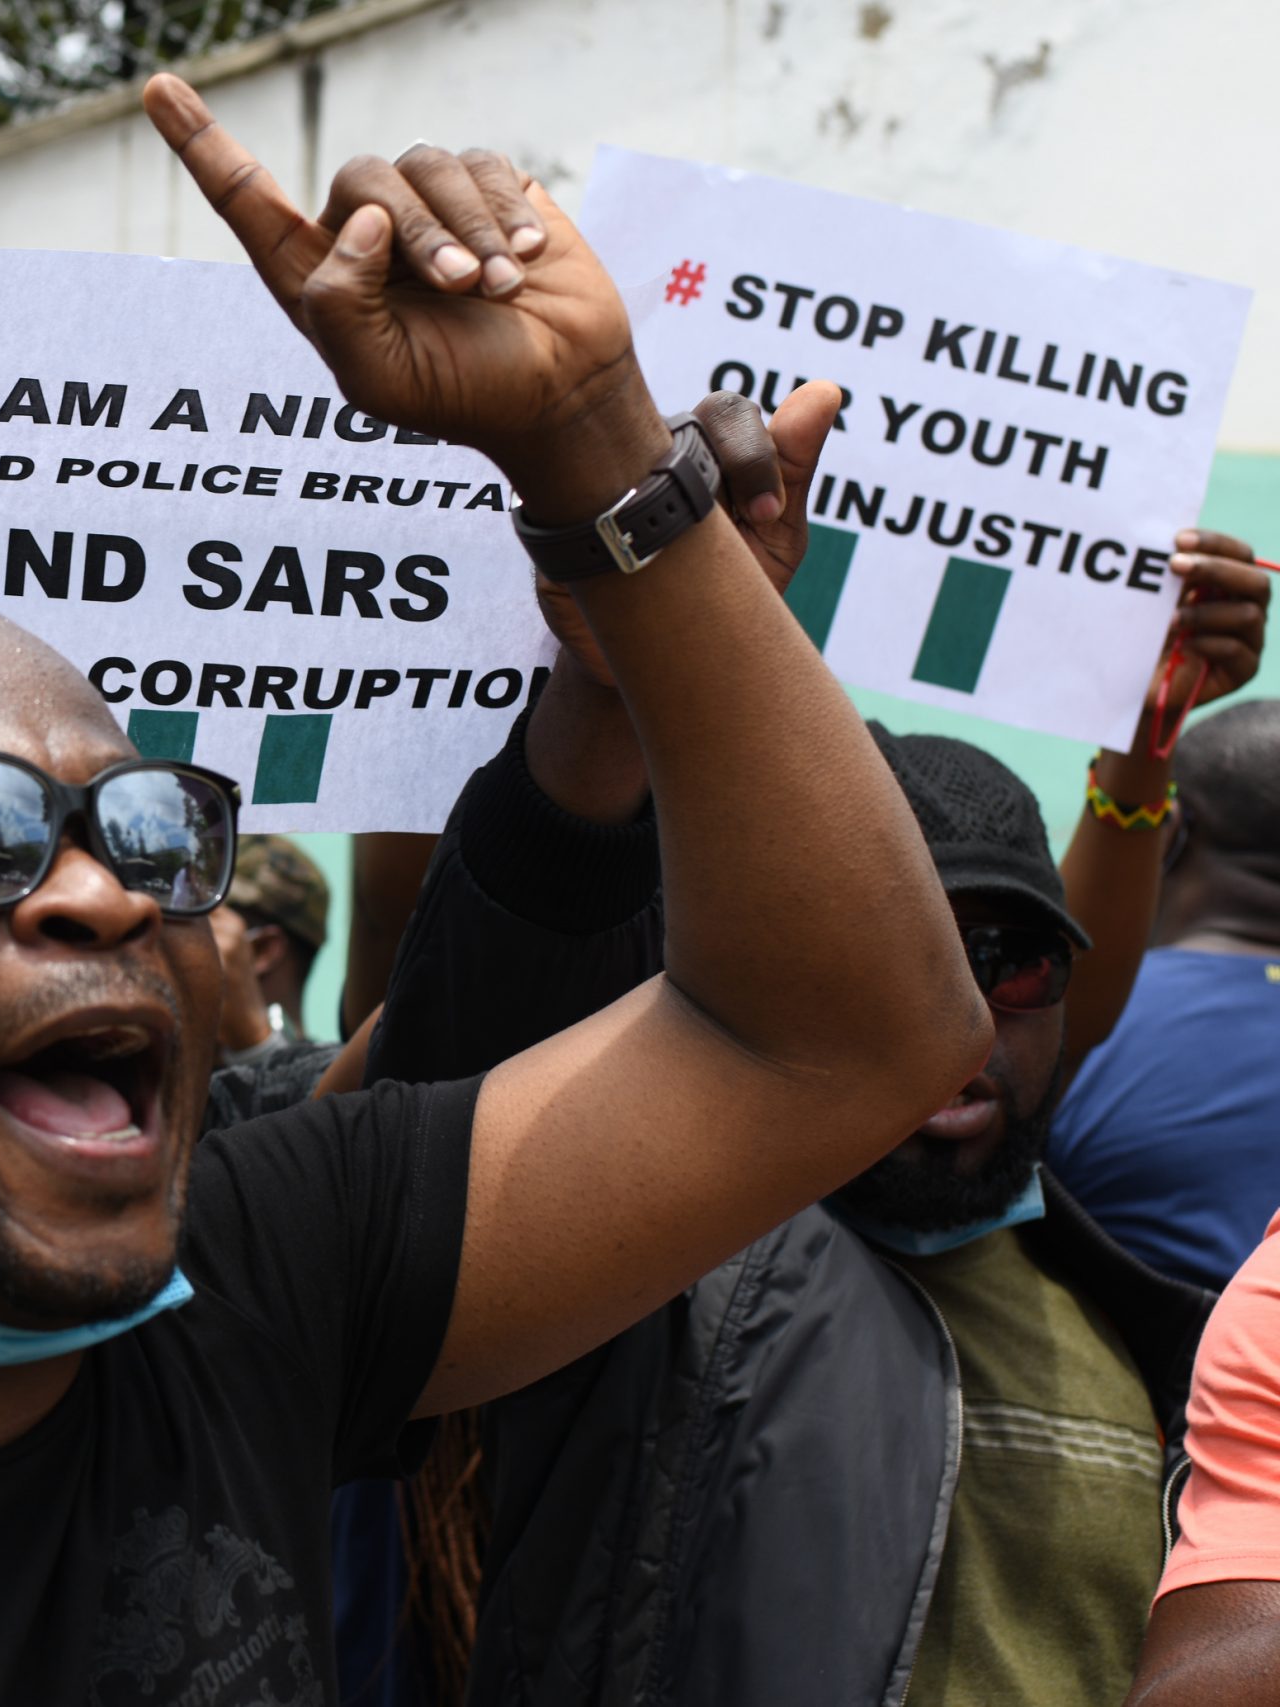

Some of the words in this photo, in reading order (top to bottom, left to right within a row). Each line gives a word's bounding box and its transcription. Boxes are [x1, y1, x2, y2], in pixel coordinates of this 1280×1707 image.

[664, 259, 707, 306] #
[724, 274, 904, 349] STOP
[923, 318, 1189, 417] KILLING
[149, 388, 209, 434] A
[239, 392, 466, 446] NIG
[879, 395, 1109, 490] YOUTH
[55, 457, 283, 497] POLICE
[299, 471, 512, 512] BRUTA
[813, 474, 1170, 594] INJUSTICE
[182, 540, 450, 623] SARS
